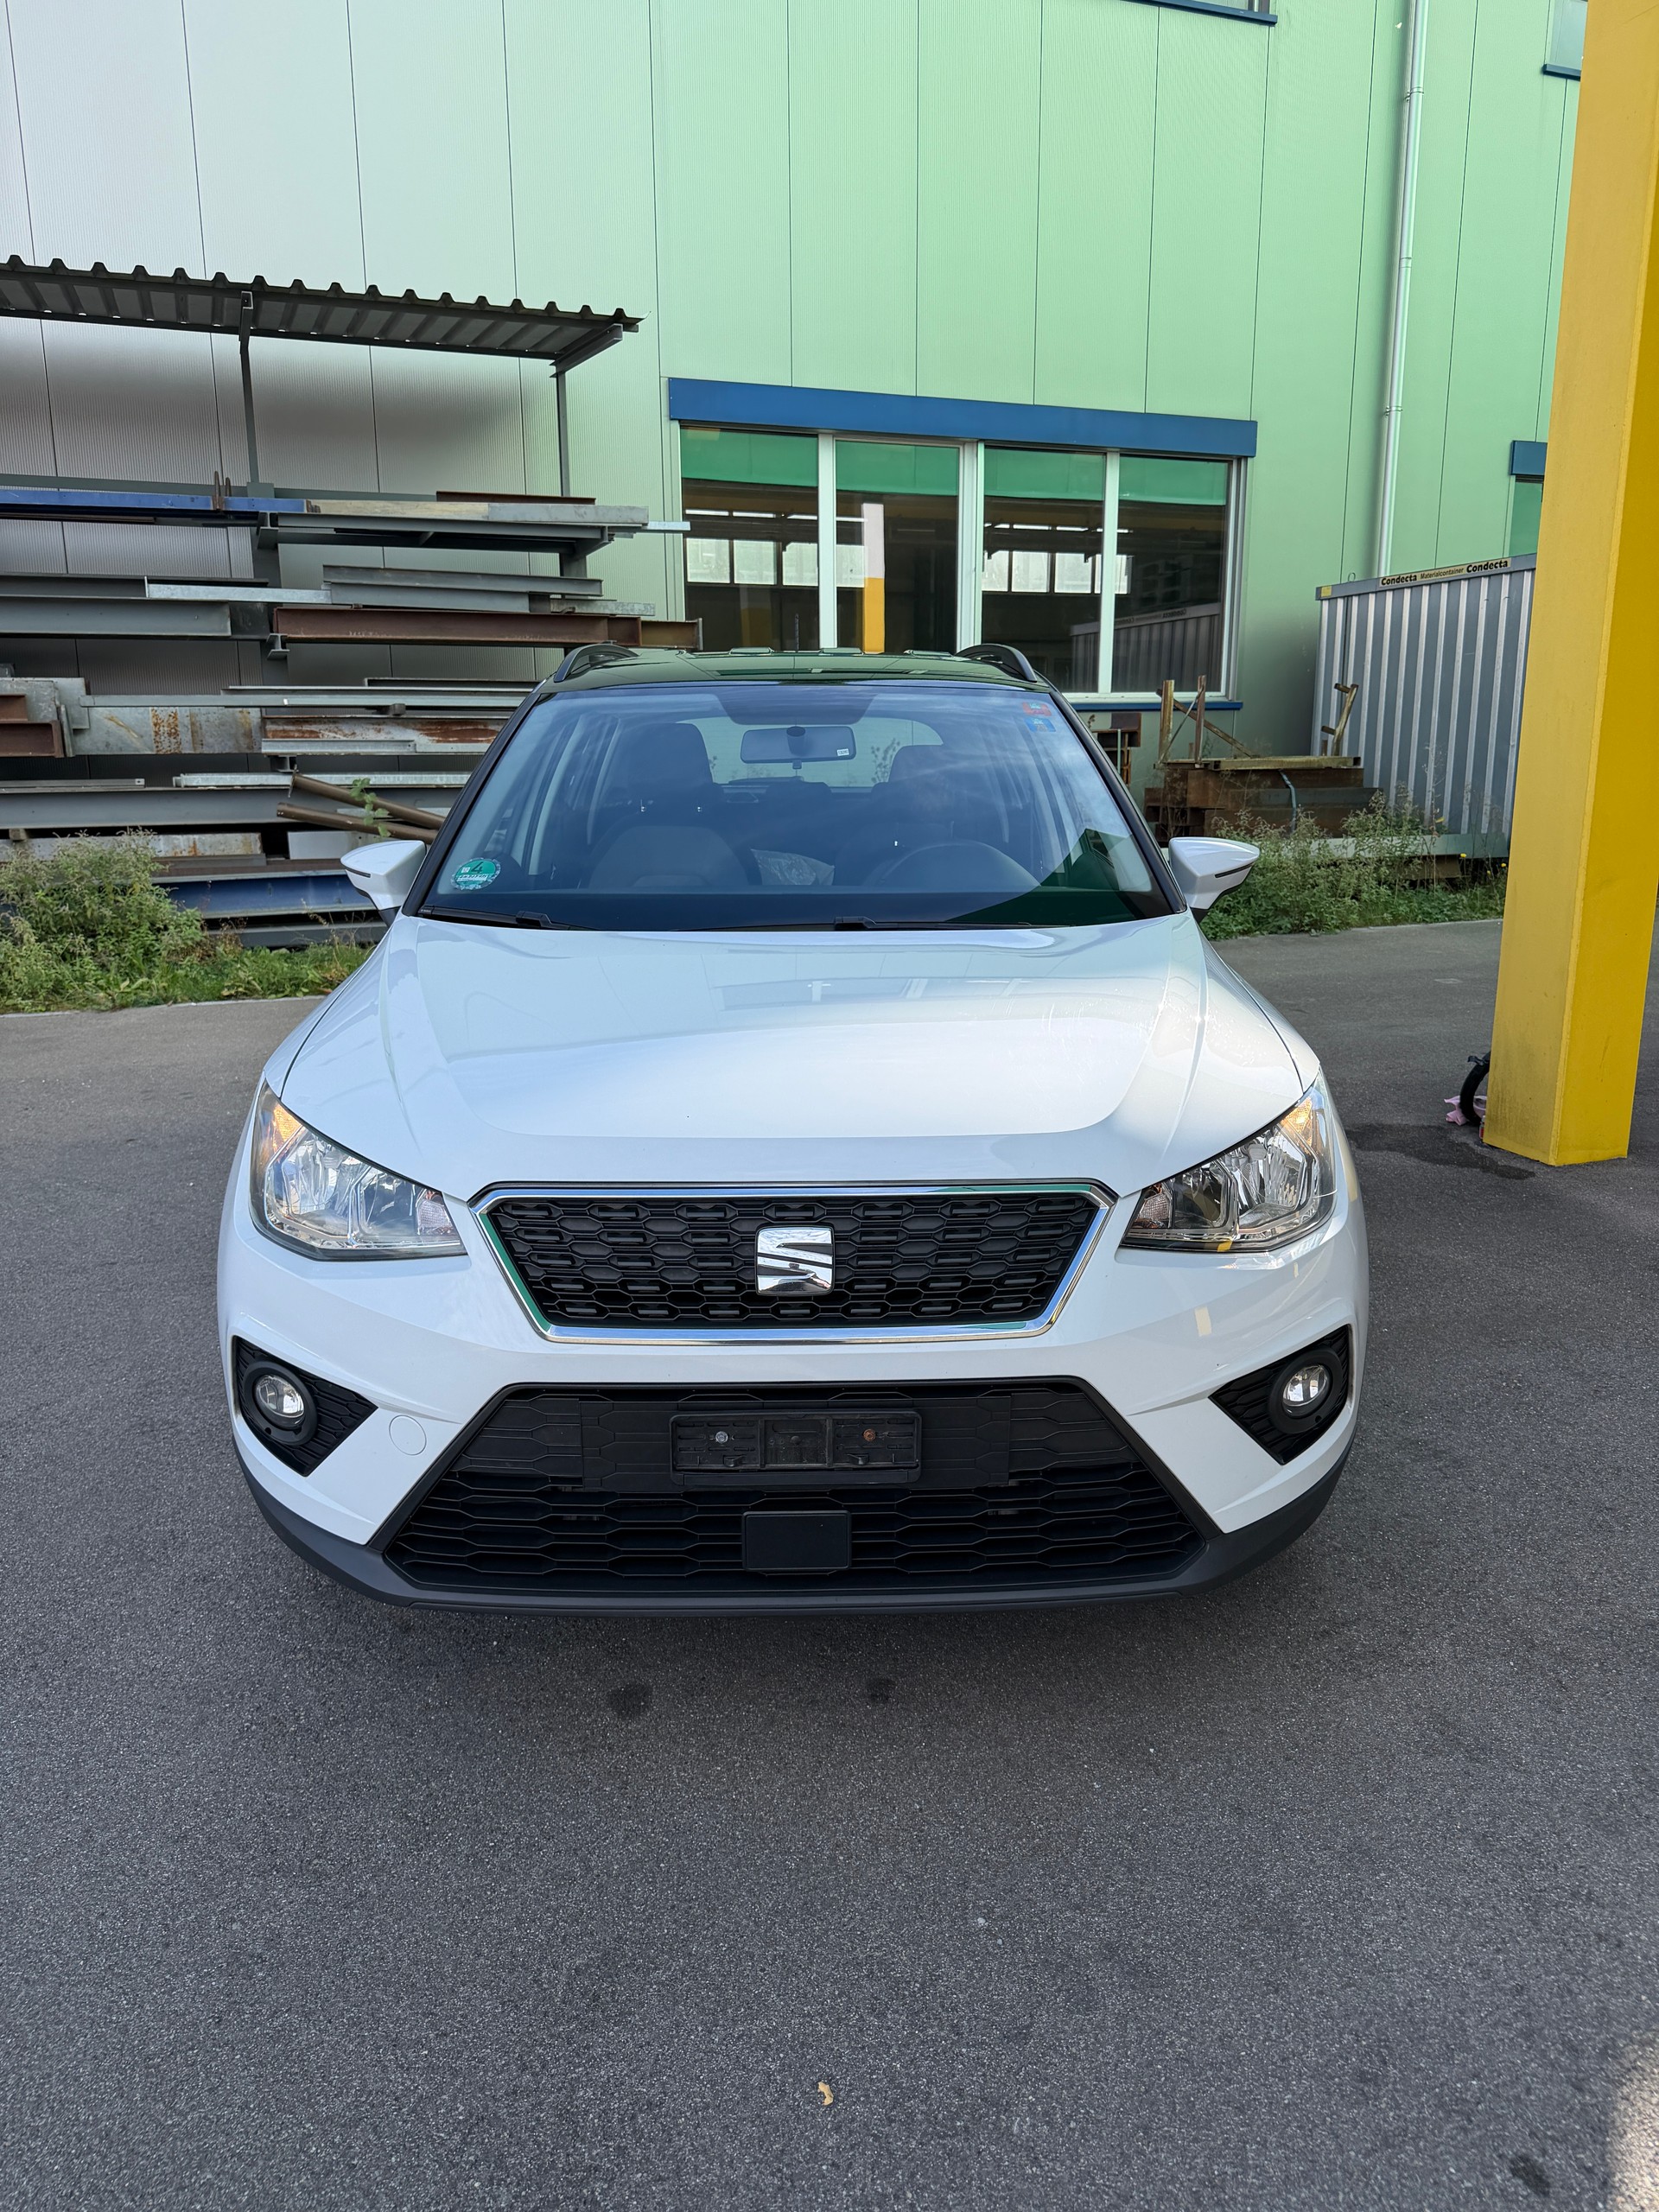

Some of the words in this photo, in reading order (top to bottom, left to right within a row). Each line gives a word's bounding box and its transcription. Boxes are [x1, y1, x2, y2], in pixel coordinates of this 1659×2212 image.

[1381, 574, 1417, 586] Condecta
[1420, 568, 1464, 579] Materialcontainer
[1466, 560, 1508, 573] Condecta
[471, 861, 484, 874] 4
